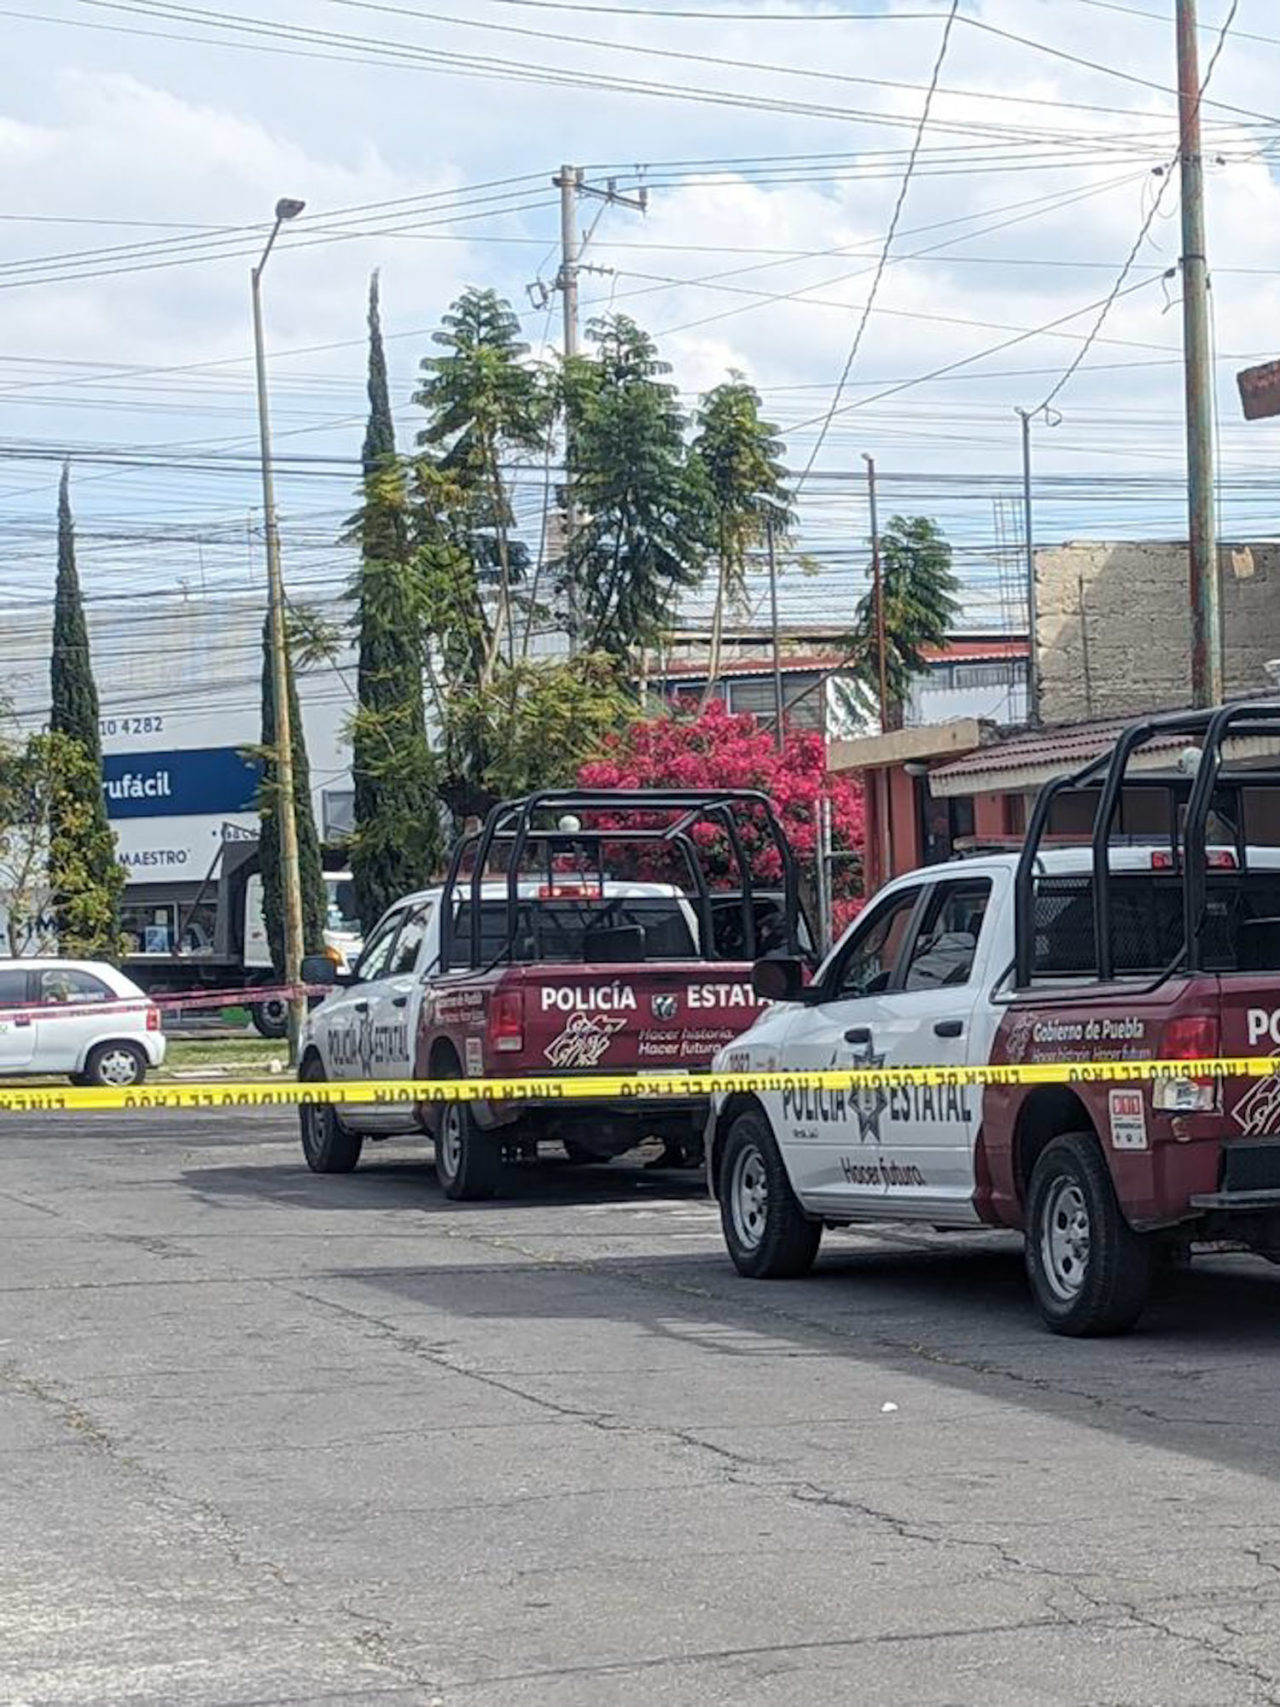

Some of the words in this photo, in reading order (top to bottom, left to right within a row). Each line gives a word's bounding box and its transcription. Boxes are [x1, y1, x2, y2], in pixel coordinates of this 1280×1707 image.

[121, 716, 164, 734] 4282
[118, 850, 187, 866] MAESTRO
[541, 980, 637, 1010] POLICÍA
[1032, 1018, 1083, 1042] Gobierno
[1084, 1019, 1100, 1039] de
[1102, 1016, 1145, 1039] Puebla
[638, 1042, 679, 1056] Hacer
[890, 1065, 972, 1122] ESTATAL
